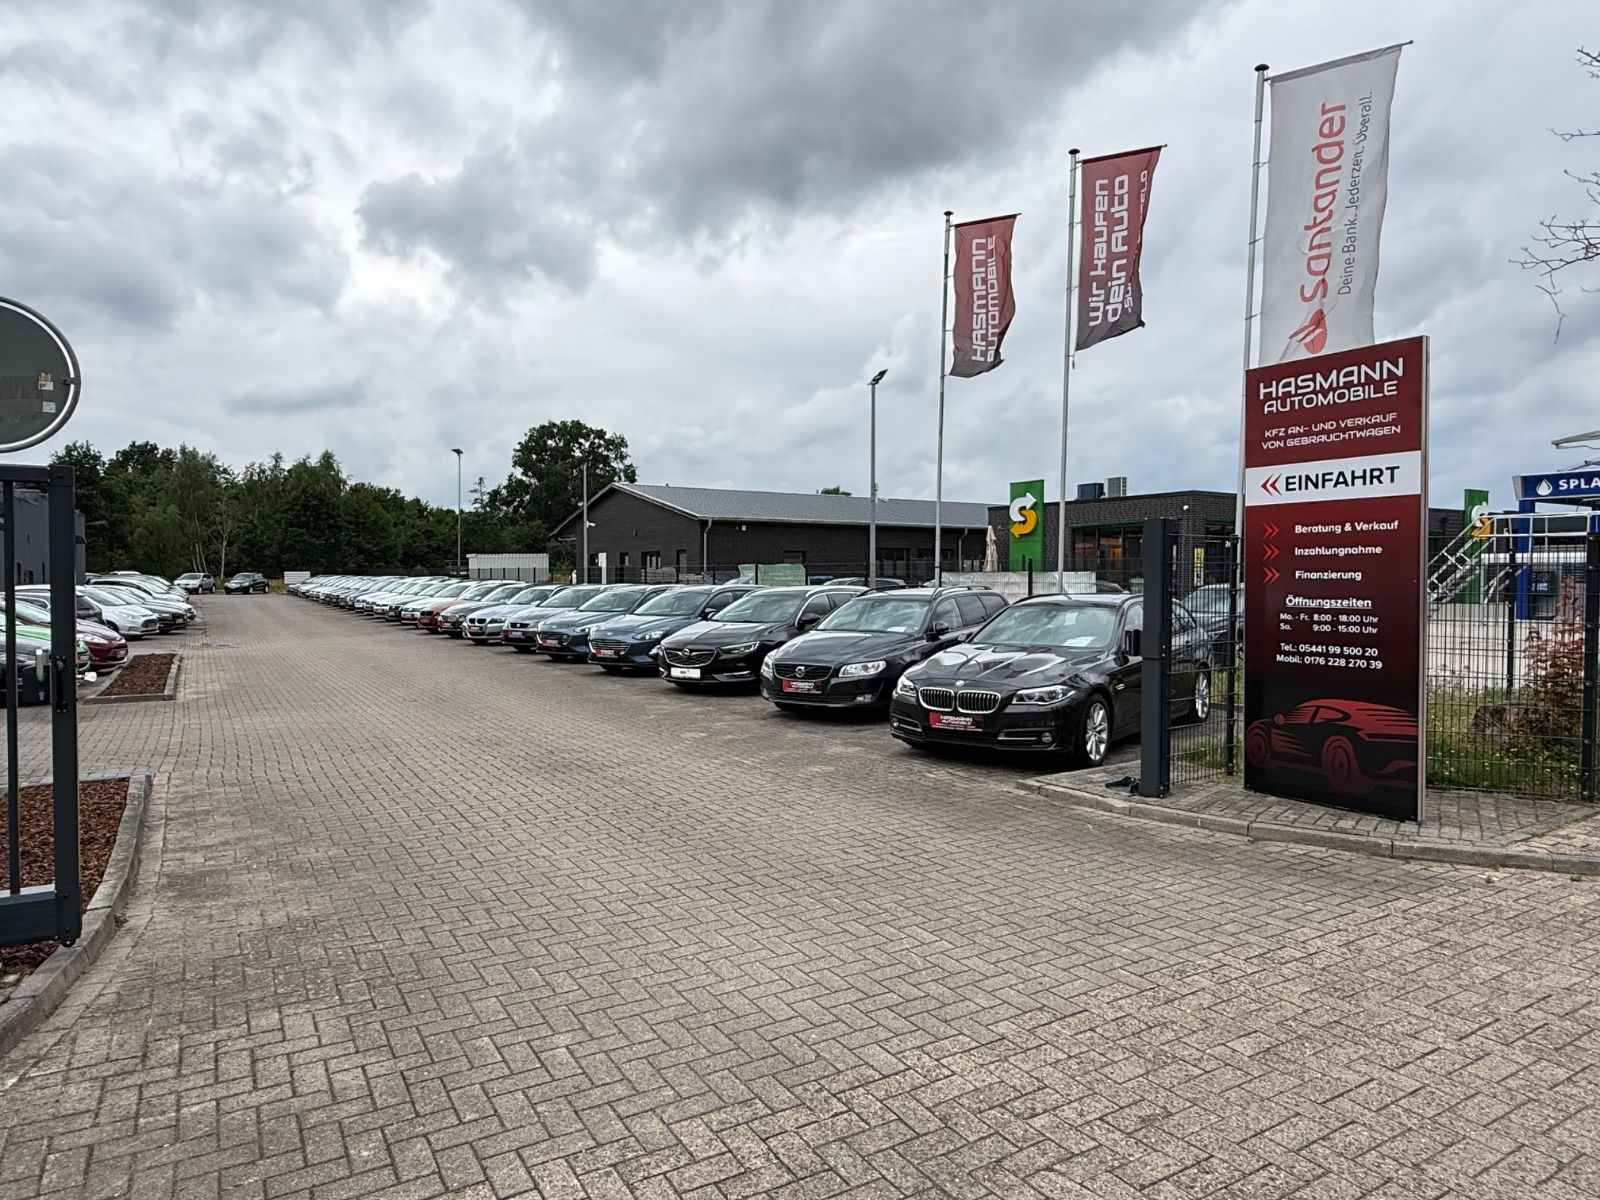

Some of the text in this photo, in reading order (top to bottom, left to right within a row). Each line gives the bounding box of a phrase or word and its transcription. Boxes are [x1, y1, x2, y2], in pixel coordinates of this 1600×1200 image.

[1353, 90, 1373, 145] Überall.
[1300, 102, 1347, 303] Santander
[1341, 213, 1358, 254] Bank.
[1106, 174, 1129, 323] dein Auto
[1337, 257, 1356, 295] Deine
[971, 238, 987, 362] HASMANN
[986, 235, 1000, 363] AUTOMOBILE
[1259, 357, 1404, 400] HASMANN
[1264, 380, 1398, 414] AUTOMOBILE
[1261, 425, 1401, 449] VON GEBRAUCHTWAGEN
[1264, 412, 1398, 438] KFZ AN- UND VERKAUF
[1284, 465, 1400, 492] EINFAHRT
[1558, 477, 1600, 490] SPLA
[1294, 520, 1399, 534] Beratung & Verkauf
[1294, 545, 1383, 557] Inzahlungnahme
[1295, 570, 1362, 581] Finanzierung
[1285, 595, 1372, 609] Öffnungszeiten
[1312, 624, 1332, 632] 9:00
[1338, 625, 1361, 633] 15:00
[1362, 626, 1378, 634] Uhr
[1313, 613, 1332, 622] 8:00
[1338, 614, 1361, 623] 18:00
[1362, 615, 1379, 623] Uhr
[1276, 654, 1383, 669] Mobil: 0176 228 270 39
[1299, 644, 1327, 653] 05441
[1327, 645, 1341, 654] 99
[1343, 646, 1363, 655] 500
[1364, 648, 1378, 657] 20
